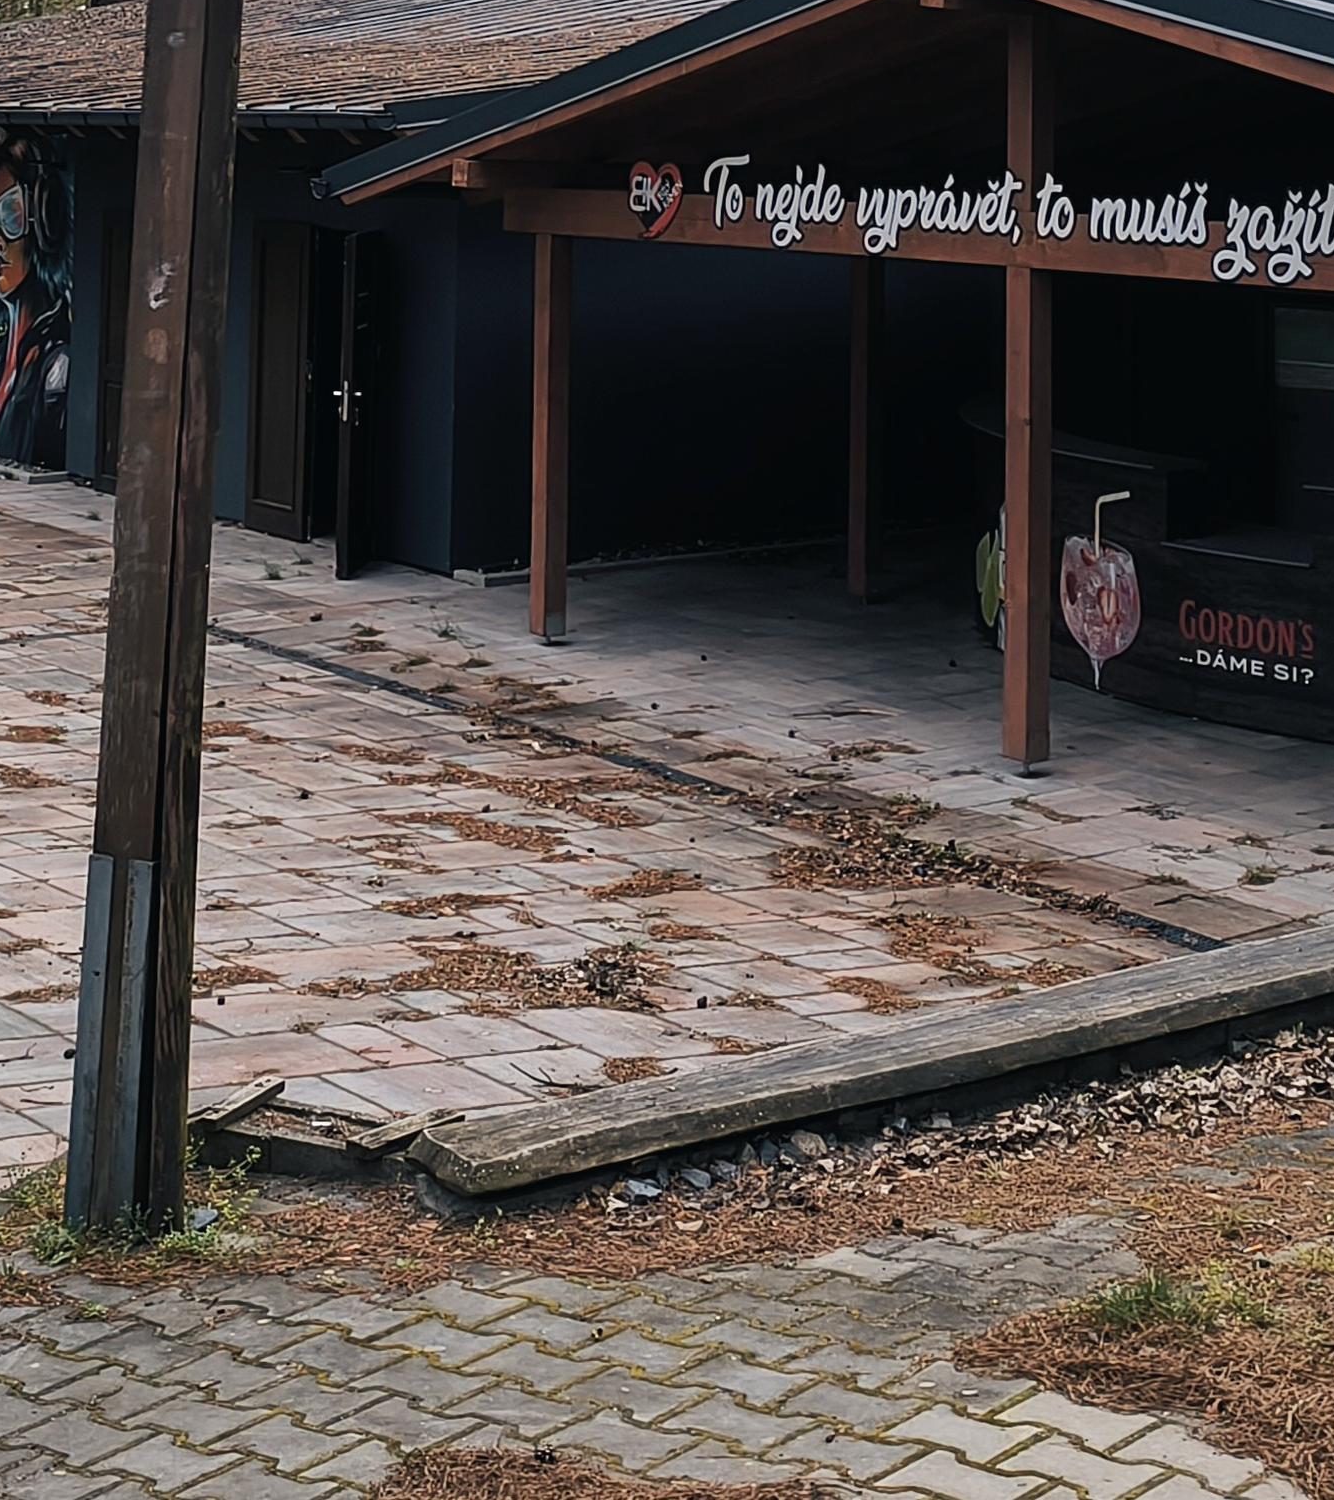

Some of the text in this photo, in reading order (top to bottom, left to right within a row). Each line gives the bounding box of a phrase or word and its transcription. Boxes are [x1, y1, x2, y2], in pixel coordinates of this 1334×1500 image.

[703, 153, 750, 229] To
[754, 163, 845, 247] nejde
[856, 169, 1022, 254] vyprávět,
[1036, 172, 1075, 239] to
[1089, 181, 1209, 245] musíš
[1178, 598, 1315, 660] GORDON'S
[1273, 662, 1315, 685] SI?
